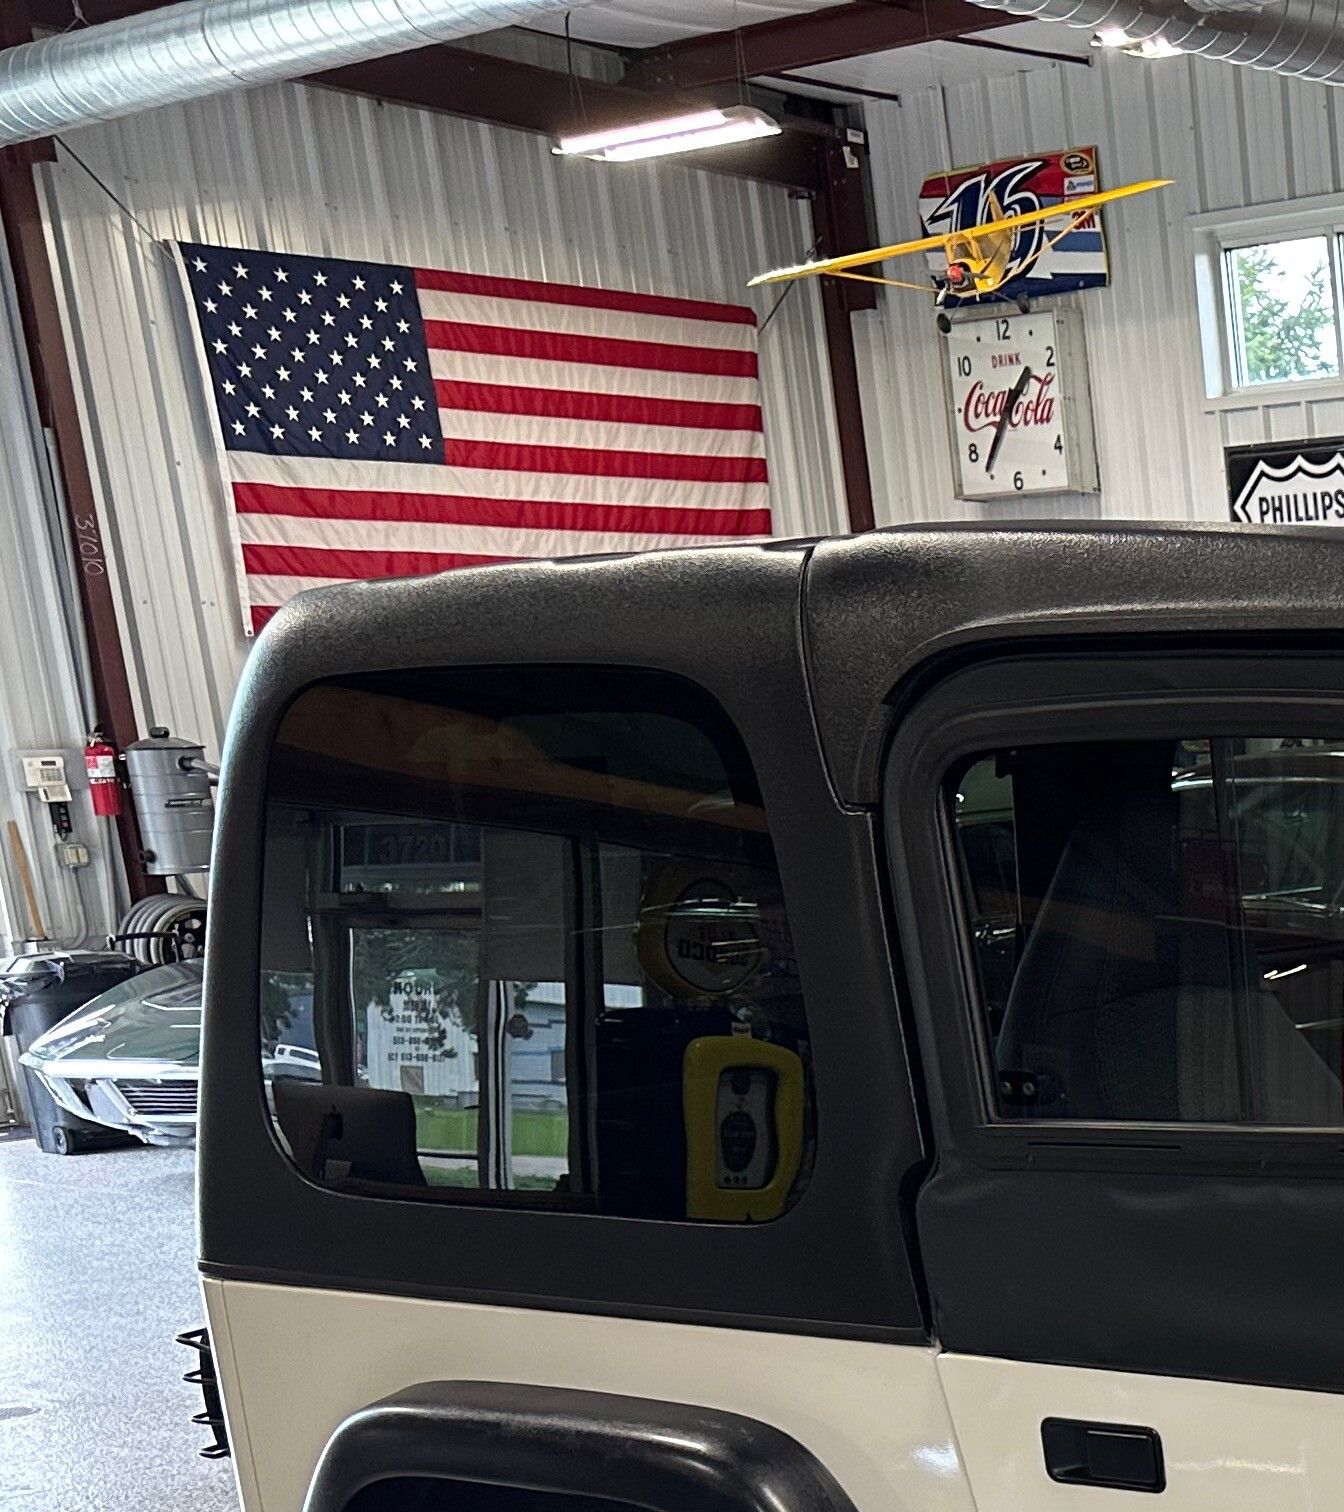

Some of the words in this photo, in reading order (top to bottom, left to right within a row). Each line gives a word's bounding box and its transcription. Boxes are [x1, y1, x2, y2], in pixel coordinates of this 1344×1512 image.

[924, 160, 1045, 288] 16
[996, 319, 1011, 341] 12
[957, 355, 972, 377] 10
[991, 352, 1022, 369] DRINK
[1045, 345, 1056, 367] 2
[963, 372, 1055, 433] CocaCola
[968, 442, 979, 463] 8
[1053, 434, 1064, 455] 4
[1013, 470, 1024, 491] 6
